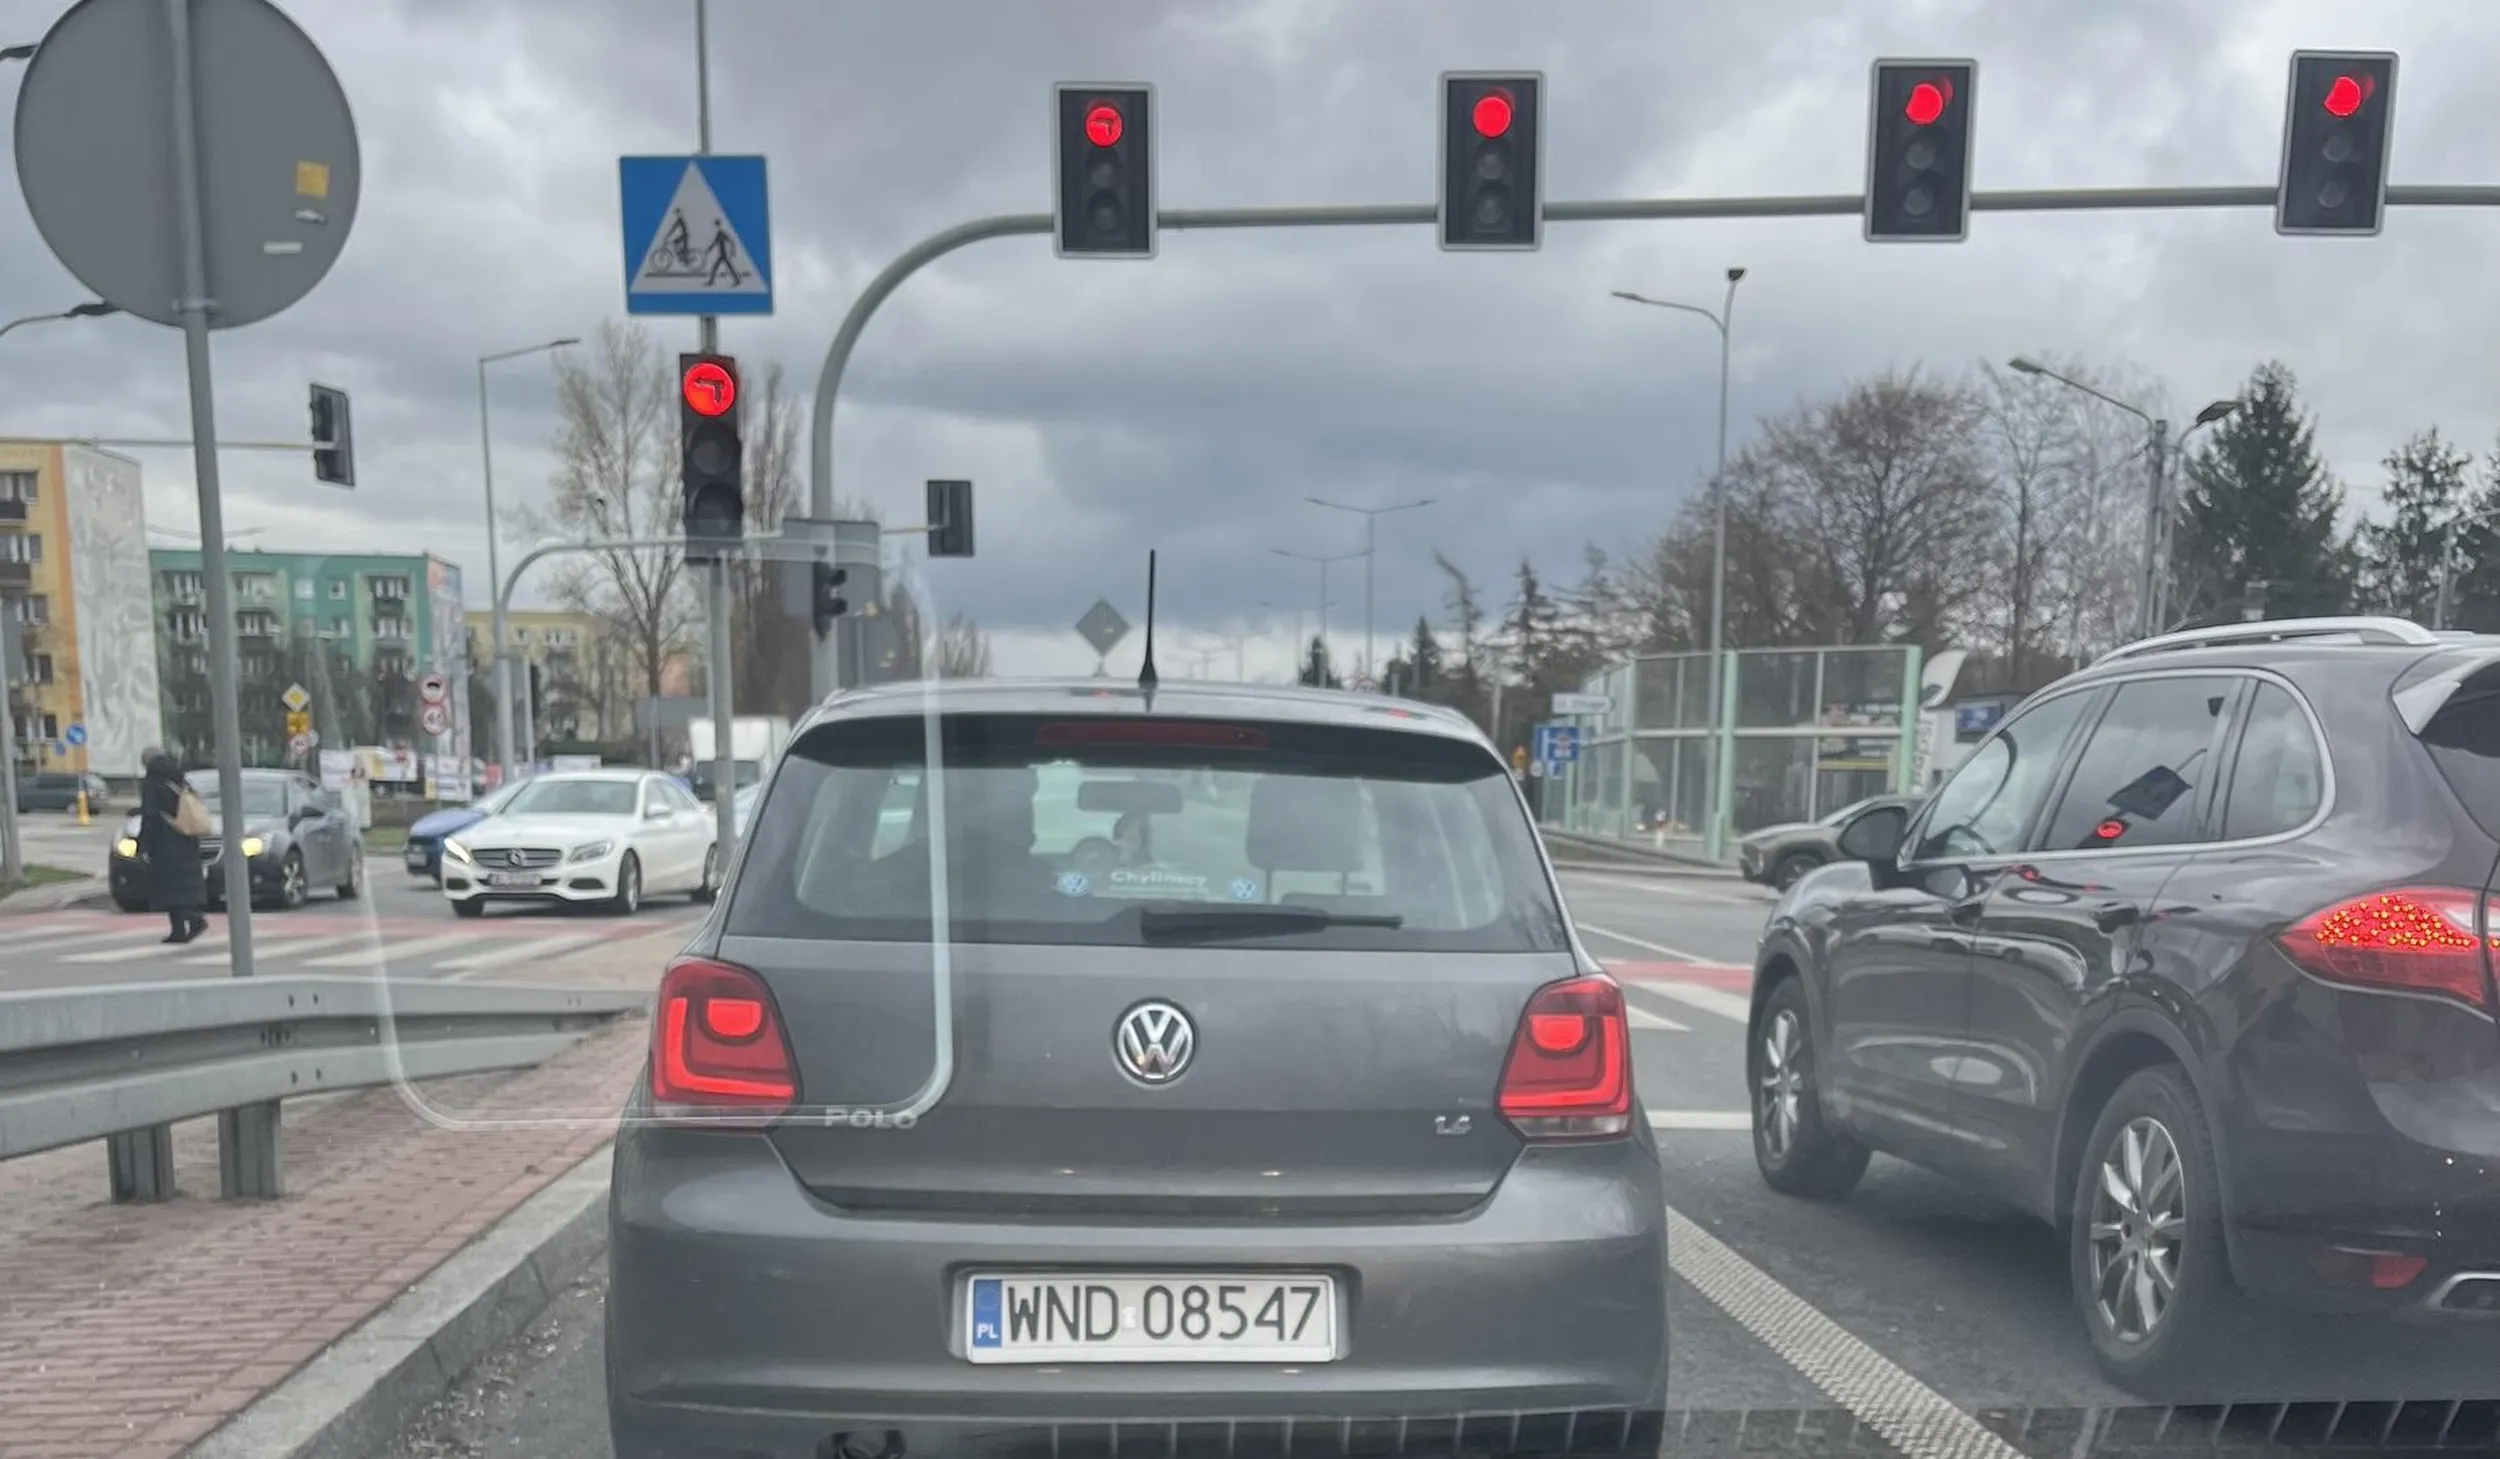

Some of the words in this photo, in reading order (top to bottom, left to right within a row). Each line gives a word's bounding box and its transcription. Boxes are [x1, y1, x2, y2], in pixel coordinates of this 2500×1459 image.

[825, 1107, 918, 1129] POLO
[977, 1323, 999, 1340] PL
[1008, 1286, 1119, 1341] WND
[1143, 1284, 1321, 1341] 08547
